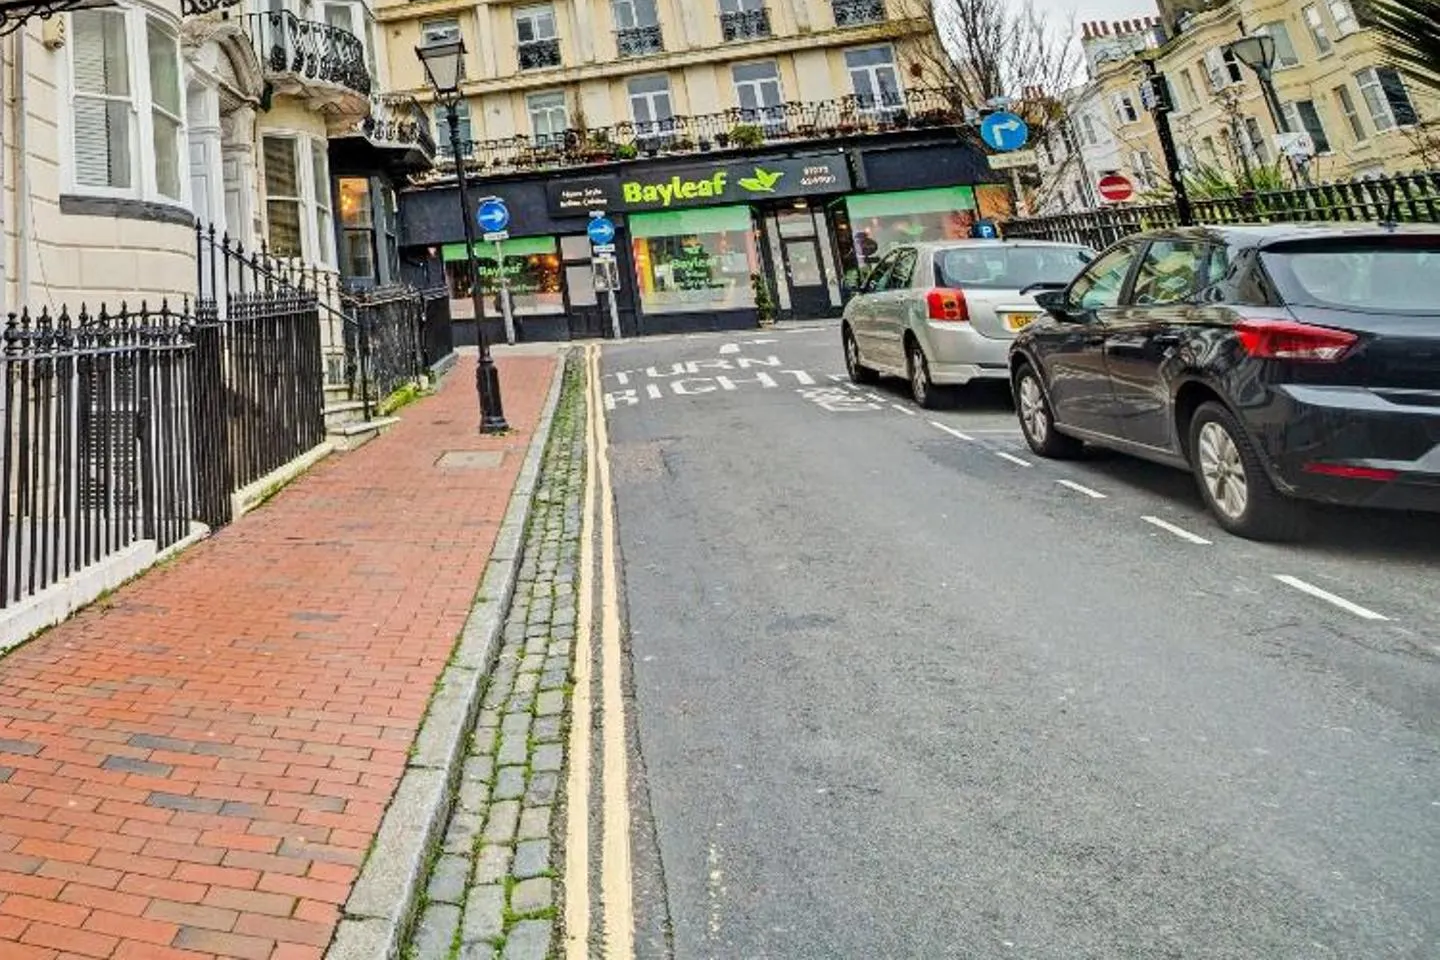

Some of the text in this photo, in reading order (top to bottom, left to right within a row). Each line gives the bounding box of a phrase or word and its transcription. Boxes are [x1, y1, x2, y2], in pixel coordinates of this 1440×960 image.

[622, 171, 728, 206] Bayleaf
[605, 355, 782, 384] TURN
[604, 370, 815, 410] RIGHT
